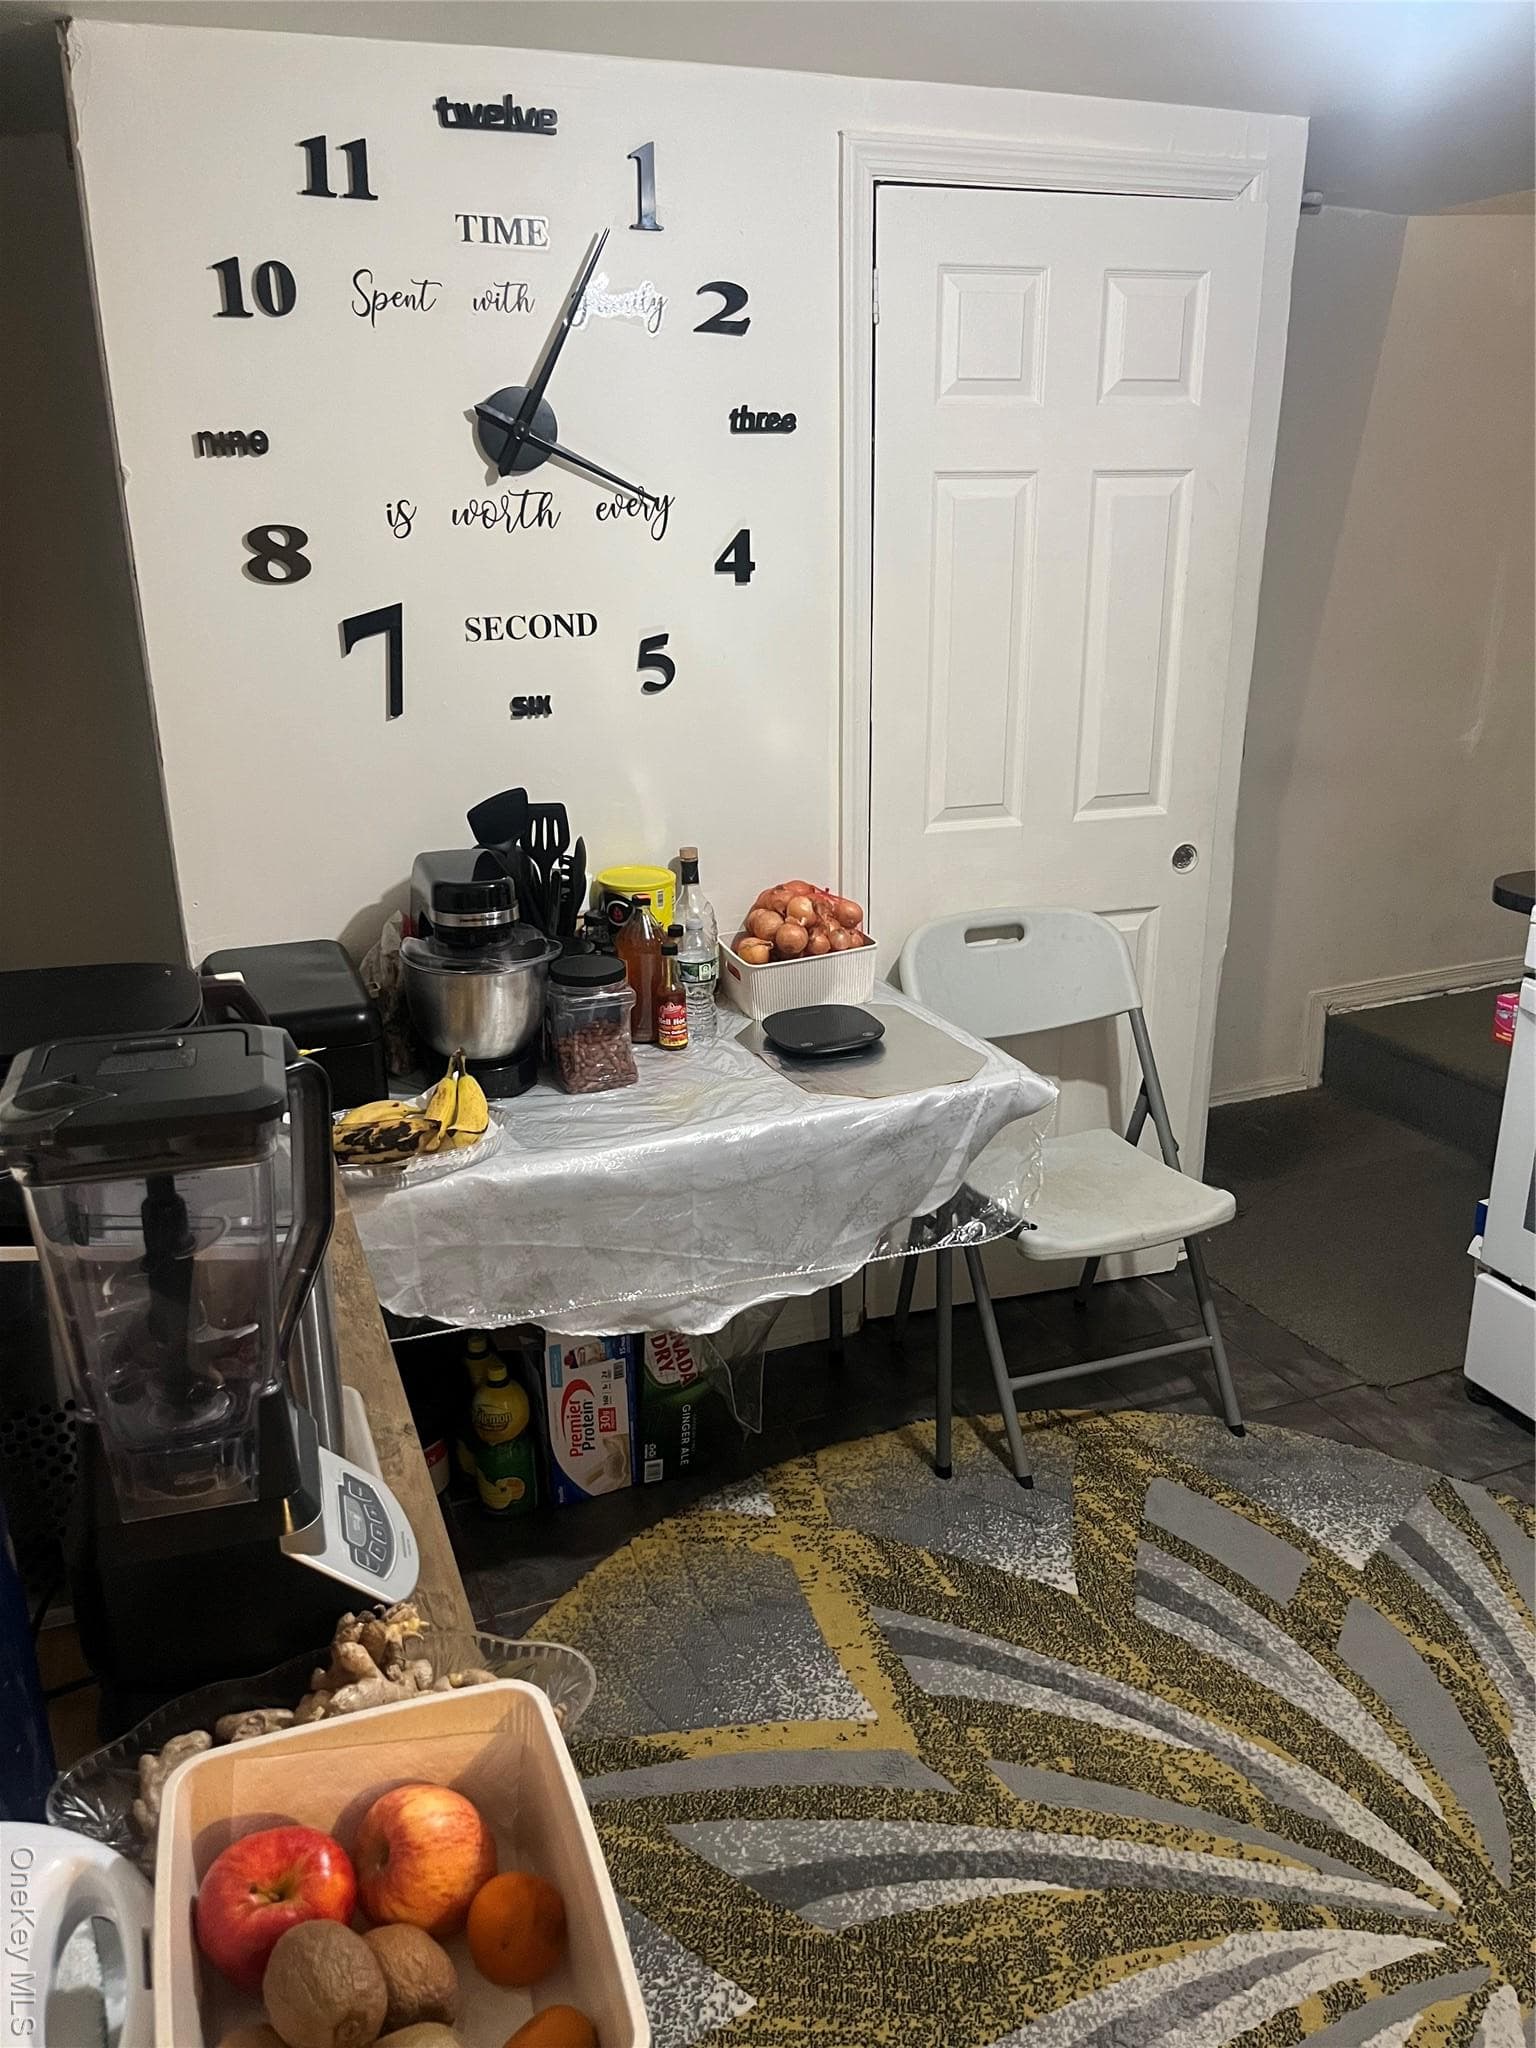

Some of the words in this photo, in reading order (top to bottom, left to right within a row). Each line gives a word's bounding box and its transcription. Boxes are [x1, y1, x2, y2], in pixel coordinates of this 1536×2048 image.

[435, 94, 558, 135] twelve
[298, 135, 378, 200] 11
[627, 142, 664, 231] 1
[456, 214, 548, 247] TIME
[210, 257, 297, 317] 10
[352, 268, 442, 327] Spent
[473, 281, 535, 313] with
[693, 281, 751, 336] 2
[196, 429, 268, 457] nine
[729, 405, 796, 433] three
[386, 499, 416, 538] is
[452, 489, 561, 533] worth
[596, 487, 674, 540] every
[243, 524, 311, 584] 8
[714, 529, 755, 583] 4
[464, 612, 598, 642] SECOND
[341, 603, 403, 719] 7
[637, 633, 675, 693] 5
[511, 695, 552, 718] six
[651, 1335, 675, 1371] DRY
[669, 1331, 697, 1385] NADA
[569, 1400, 583, 1457] Premier
[582, 1401, 596, 1450] Protein
[681, 1404, 691, 1445] GINGER
[680, 1446, 690, 1466] ALE
